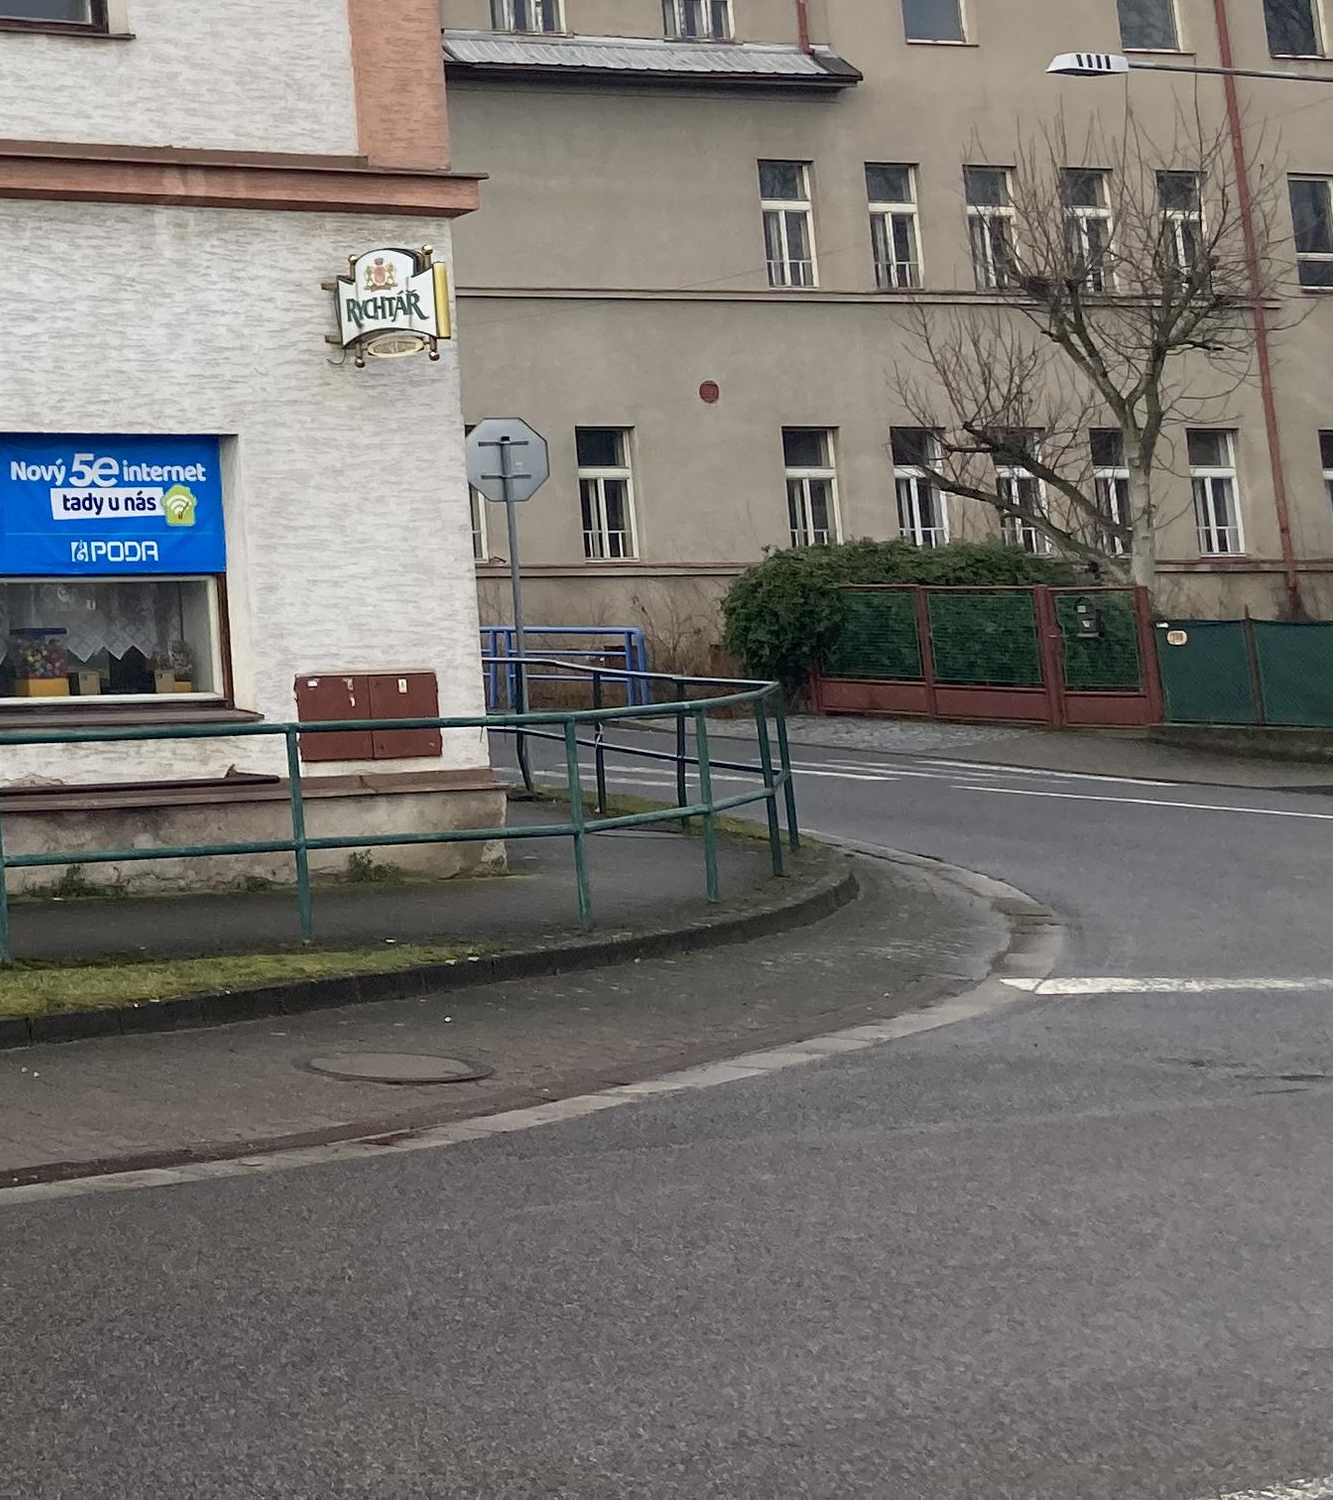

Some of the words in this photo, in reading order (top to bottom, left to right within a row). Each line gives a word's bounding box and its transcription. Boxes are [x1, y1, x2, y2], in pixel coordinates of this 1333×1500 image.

[345, 289, 429, 329] RYCHTÁŘ
[10, 458, 66, 486] Nový
[68, 452, 120, 488] 5e
[122, 459, 207, 483] internet
[62, 492, 104, 516] tady
[108, 500, 120, 512] u
[124, 490, 157, 512] nás
[90, 541, 159, 562] PODA
